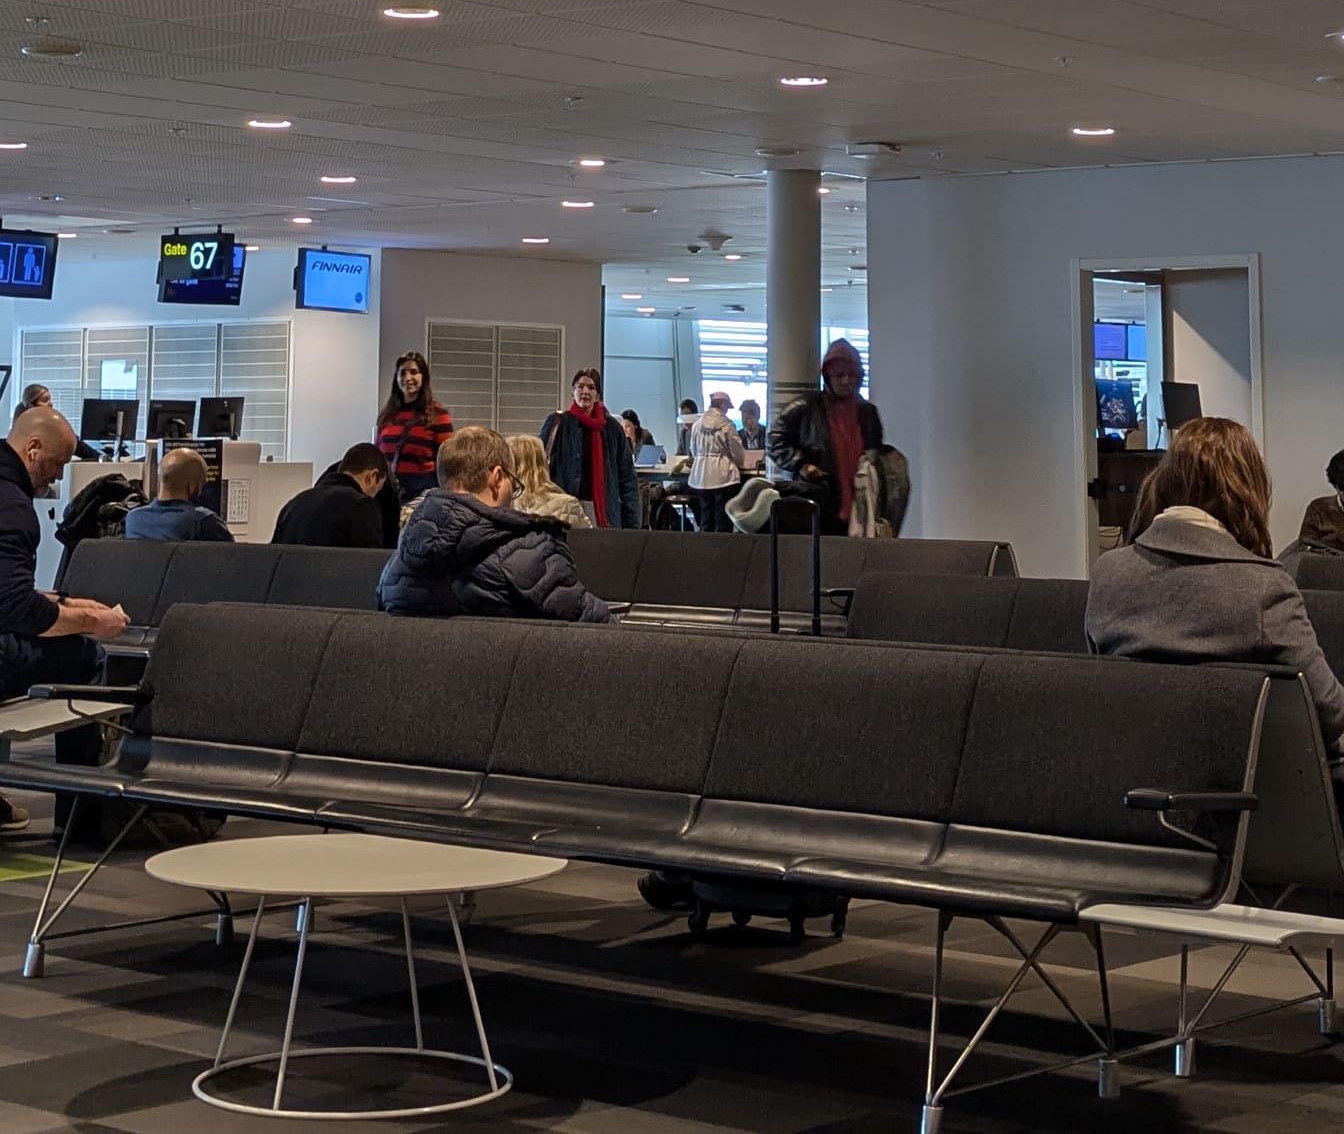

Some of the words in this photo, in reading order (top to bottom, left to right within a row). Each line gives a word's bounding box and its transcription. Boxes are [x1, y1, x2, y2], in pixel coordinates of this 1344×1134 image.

[164, 243, 187, 255] Gate
[190, 242, 218, 269] 67
[312, 261, 363, 274] FINNAIR
